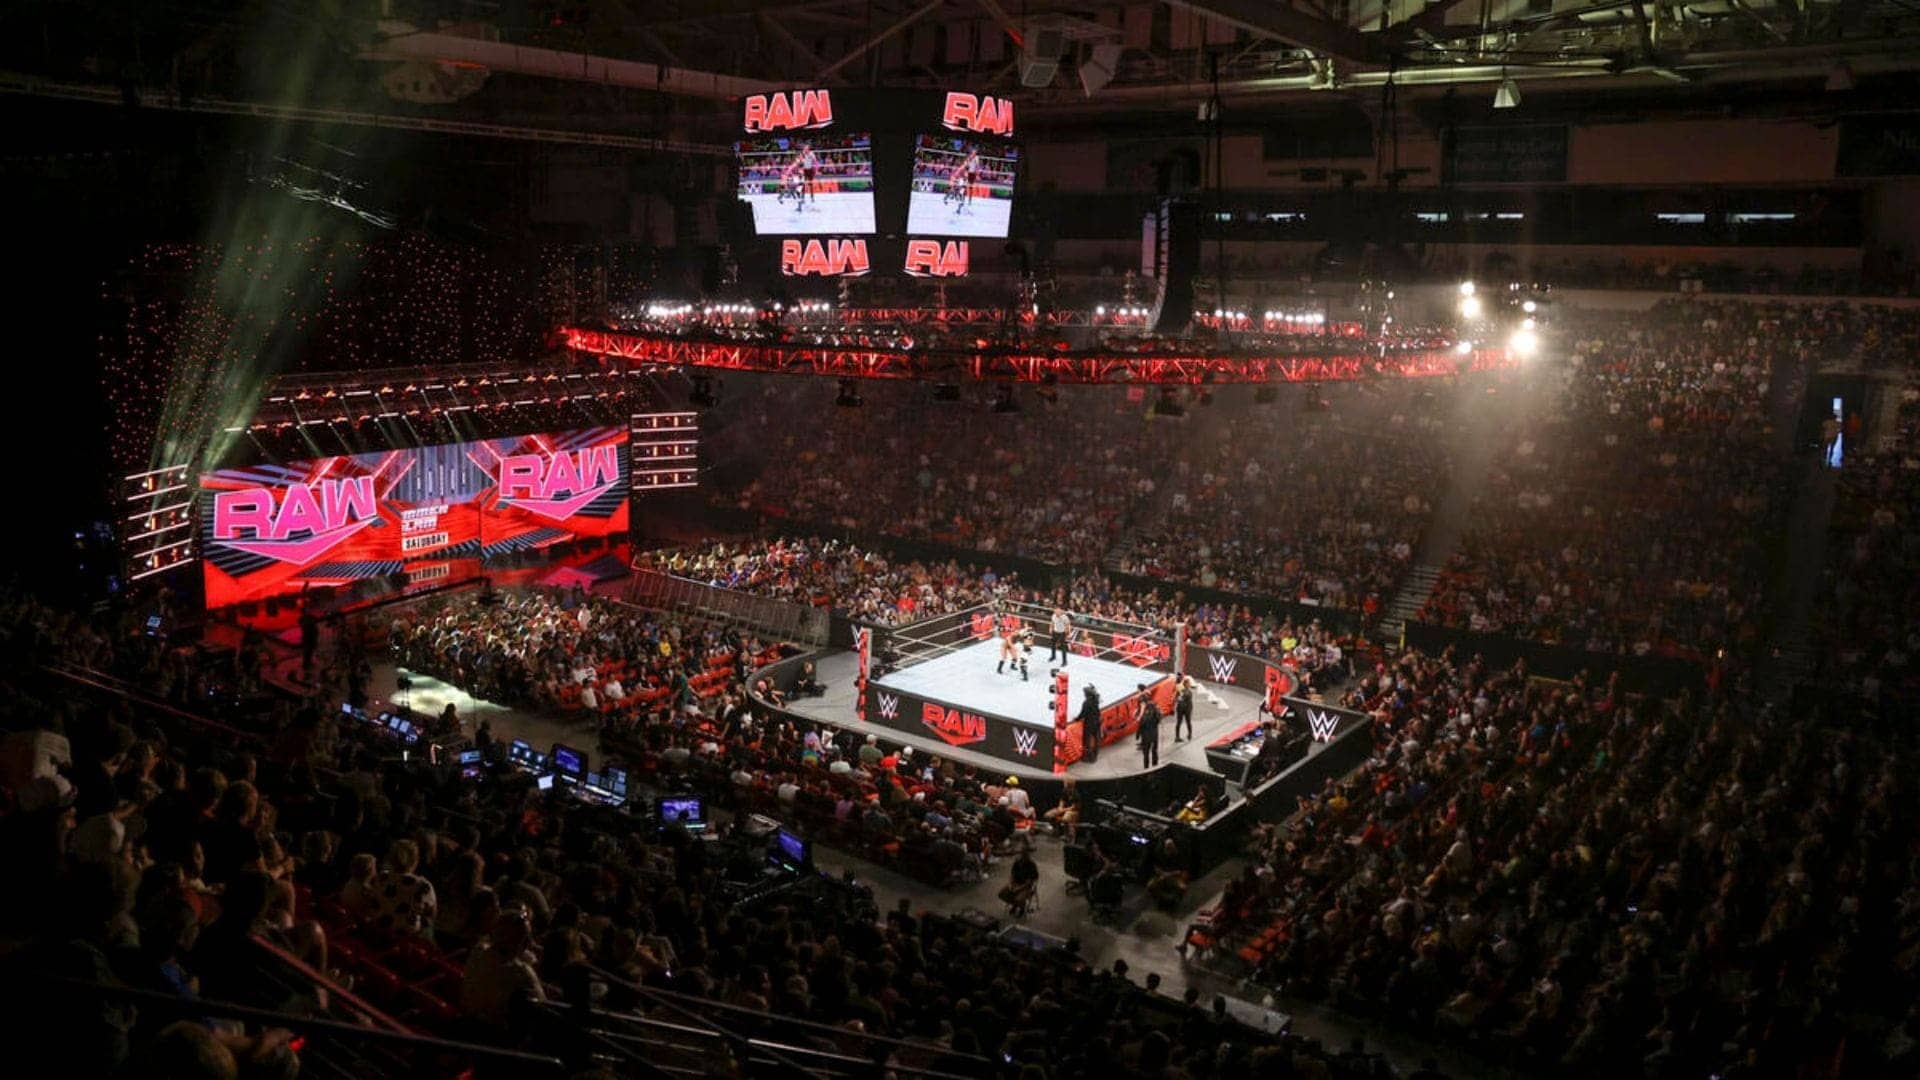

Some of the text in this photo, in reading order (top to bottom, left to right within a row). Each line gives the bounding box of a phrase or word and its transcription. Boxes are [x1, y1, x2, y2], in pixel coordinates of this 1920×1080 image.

[745, 90, 832, 130] RAW
[782, 240, 869, 275] RAW
[499, 445, 620, 498] RAW
[213, 475, 377, 540] RAW
[405, 534, 447, 549] SATURDAY
[922, 702, 986, 741] RAW
